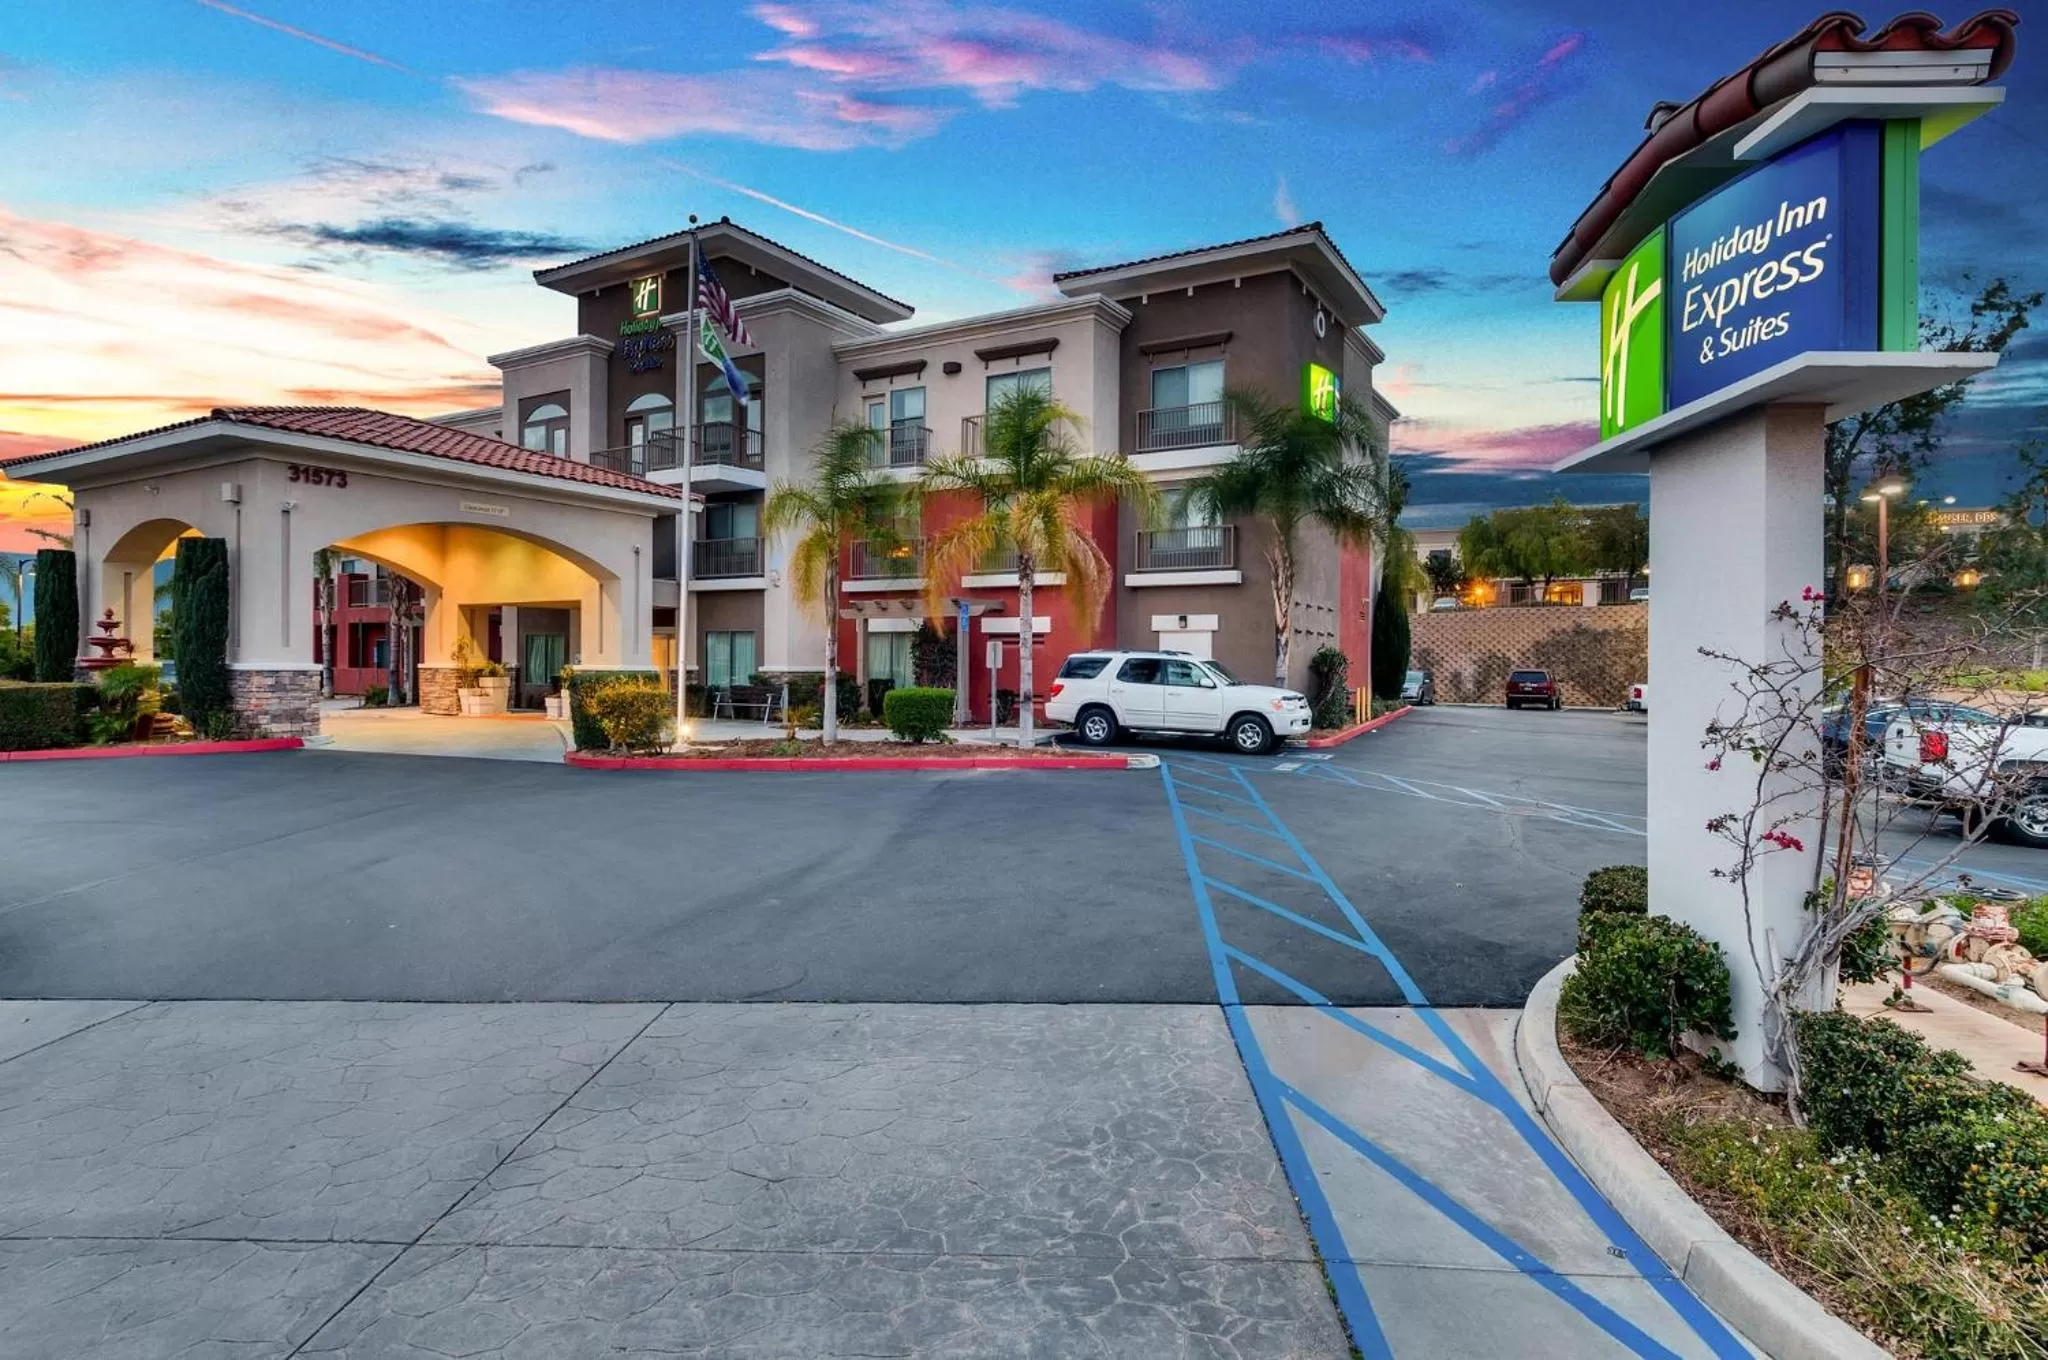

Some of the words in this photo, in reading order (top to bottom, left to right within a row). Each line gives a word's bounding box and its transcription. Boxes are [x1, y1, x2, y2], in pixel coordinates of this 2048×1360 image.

[1682, 218, 1773, 284] Holiday
[1776, 196, 1828, 237] Inn
[1681, 239, 1828, 333] Express
[1699, 336, 1714, 365] &
[1718, 312, 1791, 358] Suites
[287, 464, 348, 488] 31573
